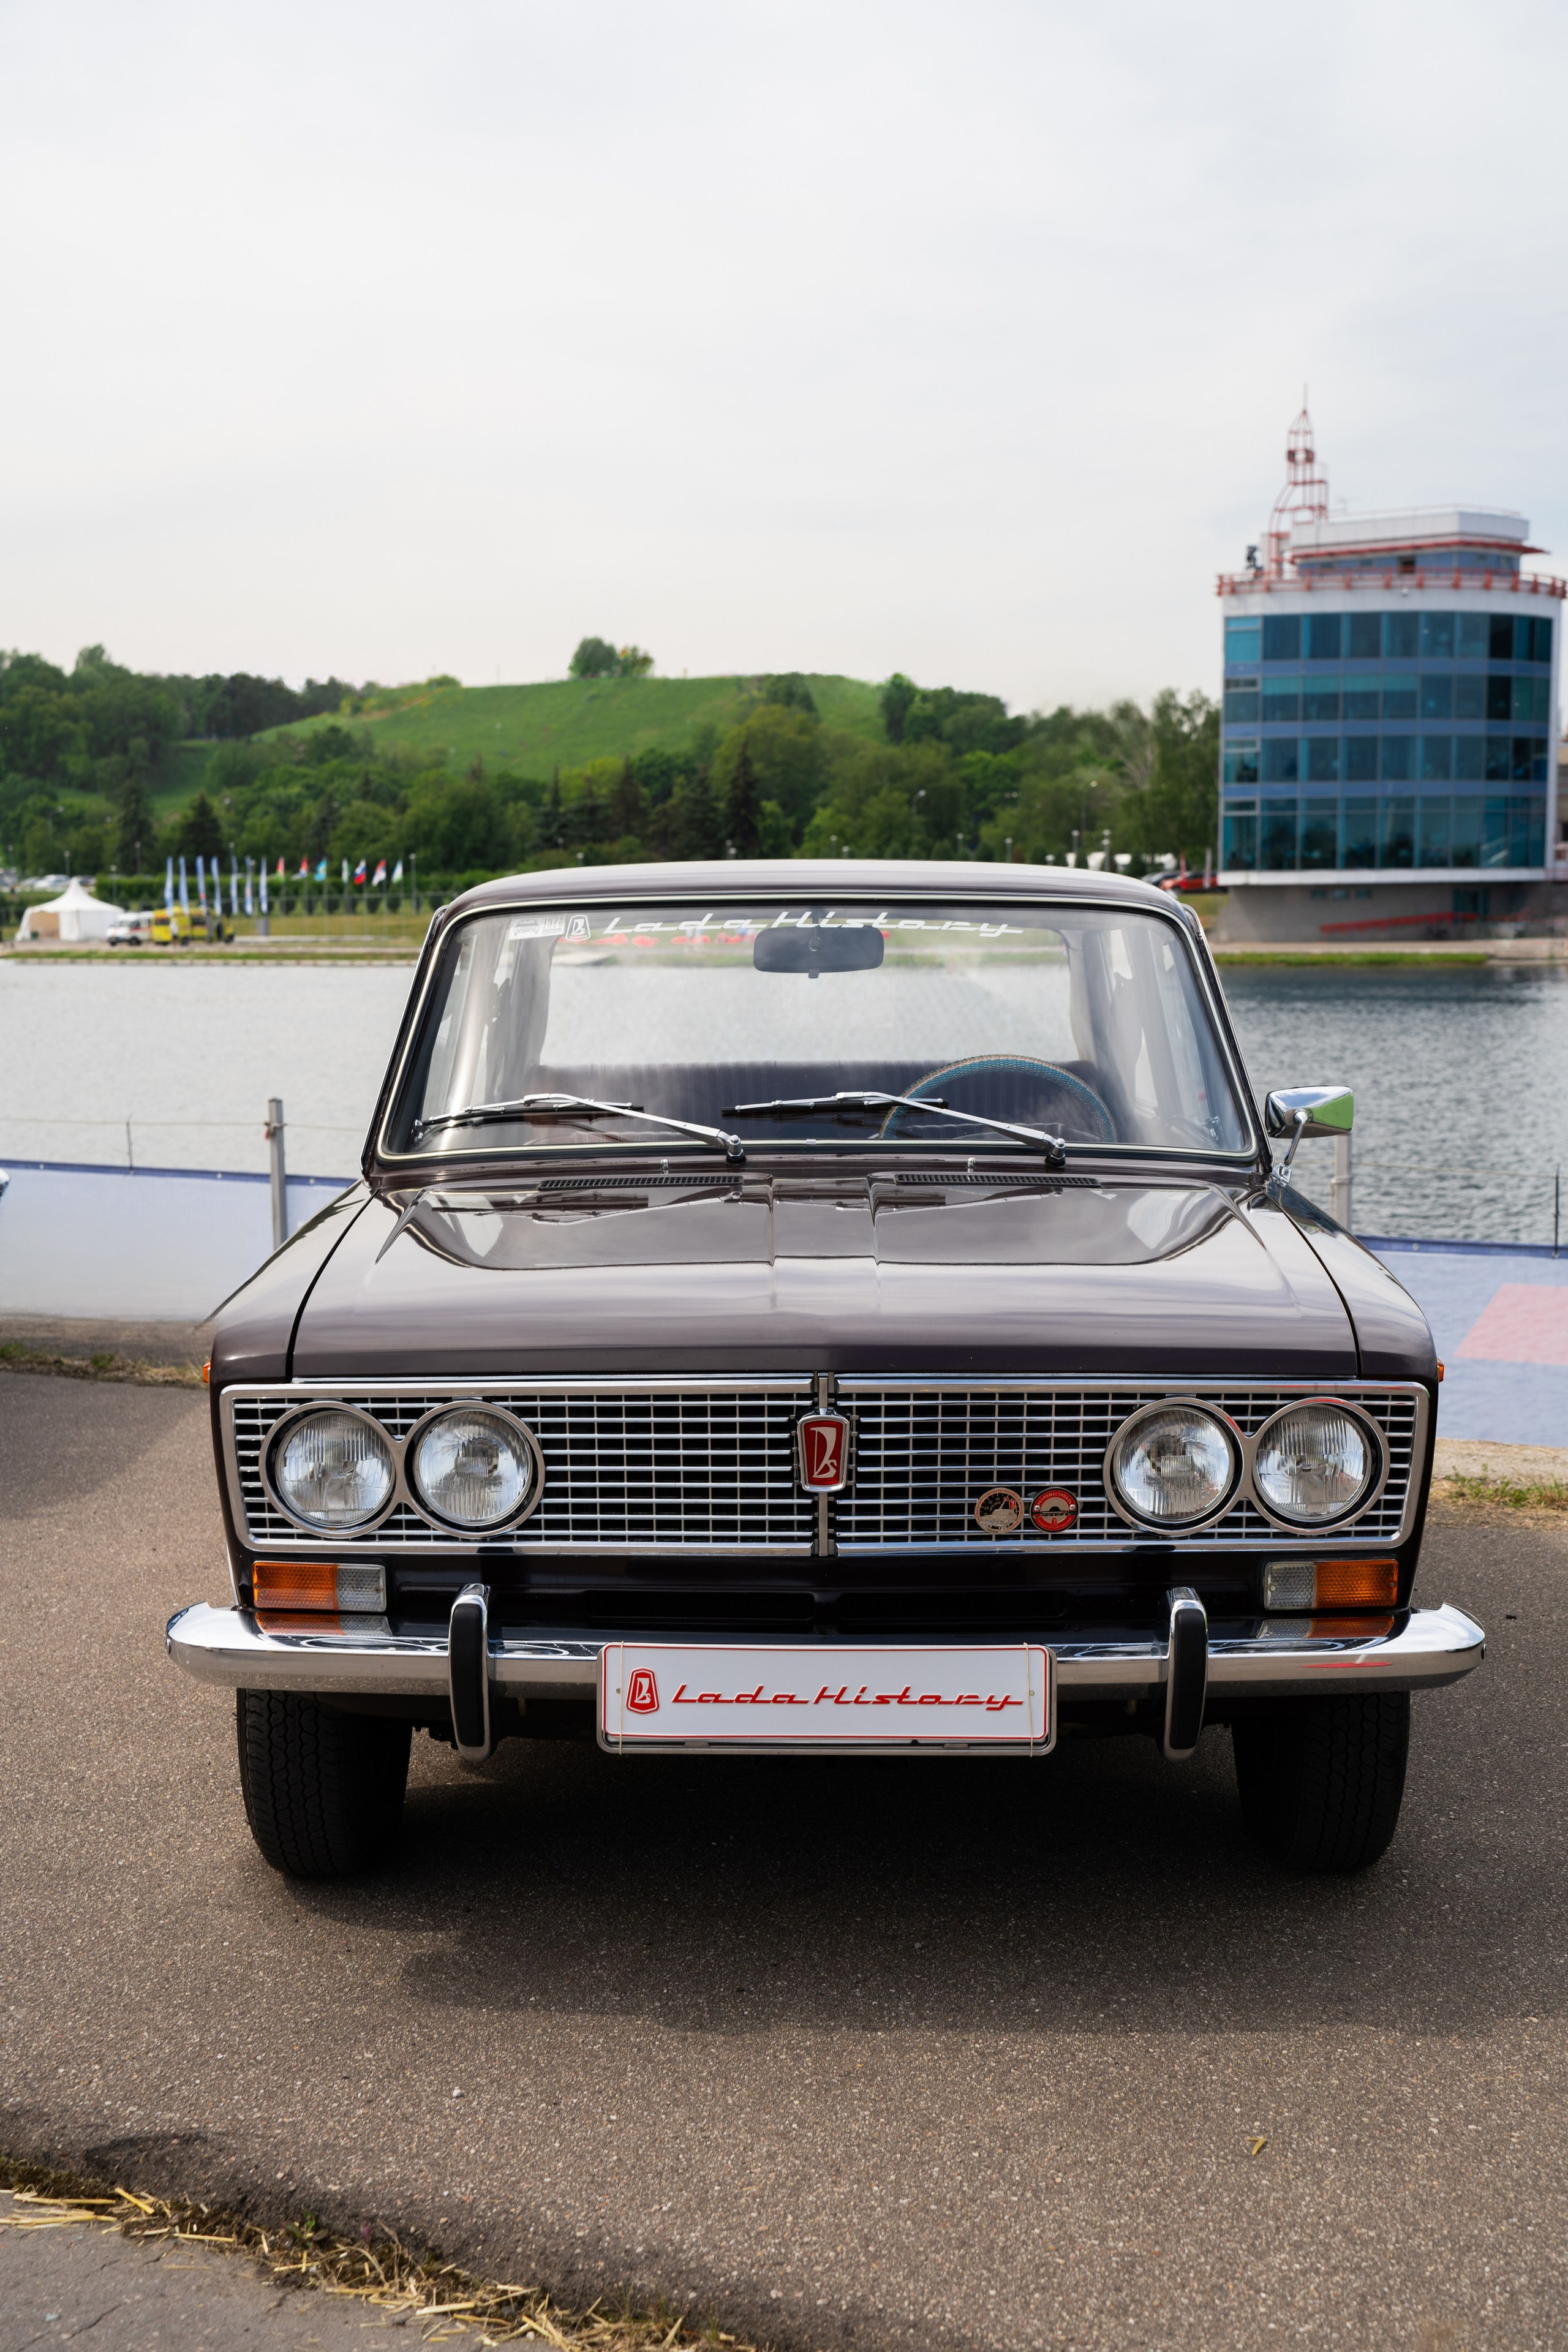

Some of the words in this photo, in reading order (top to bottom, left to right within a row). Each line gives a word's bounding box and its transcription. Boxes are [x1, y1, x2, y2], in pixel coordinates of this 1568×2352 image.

[543, 916, 564, 929] 1976
[603, 913, 767, 934] Lada
[772, 911, 1023, 937] History
[1038, 1492, 1072, 1506] РЕТРОФЕСТИВАЛЬ
[671, 1683, 809, 1704] Lada
[813, 1685, 1023, 1711] History
